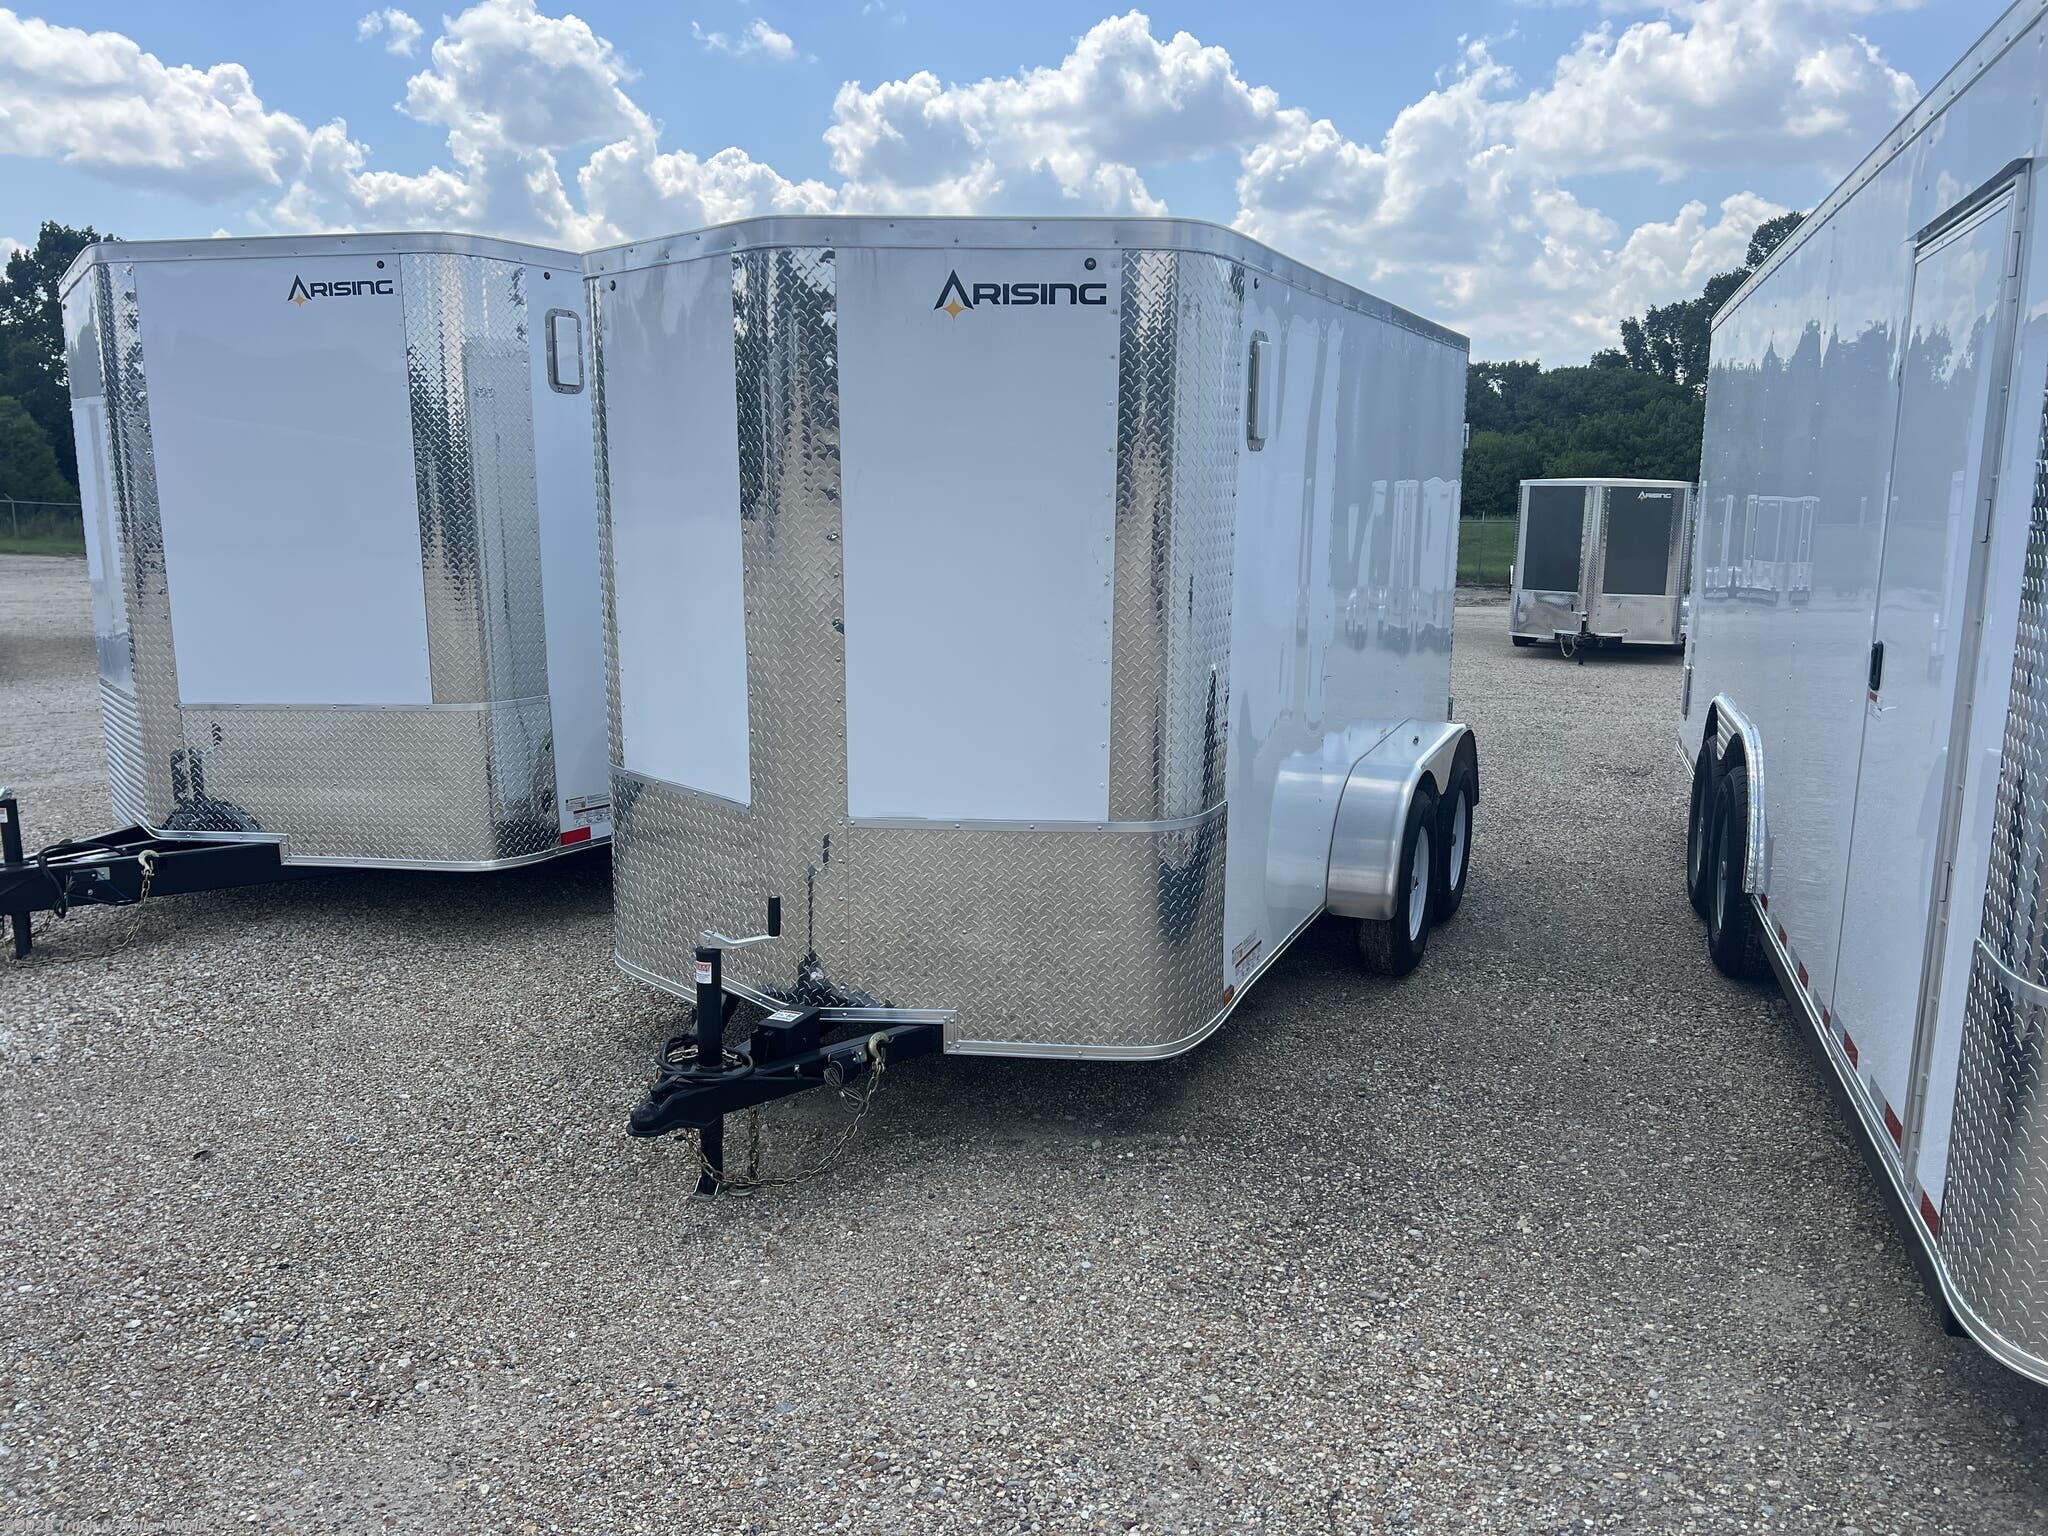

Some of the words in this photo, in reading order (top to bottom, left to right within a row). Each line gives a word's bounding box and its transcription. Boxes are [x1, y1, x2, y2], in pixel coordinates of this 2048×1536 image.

[287, 274, 394, 301] ARISING
[934, 269, 1107, 310] ARISING
[1637, 490, 1672, 499] ARNG
